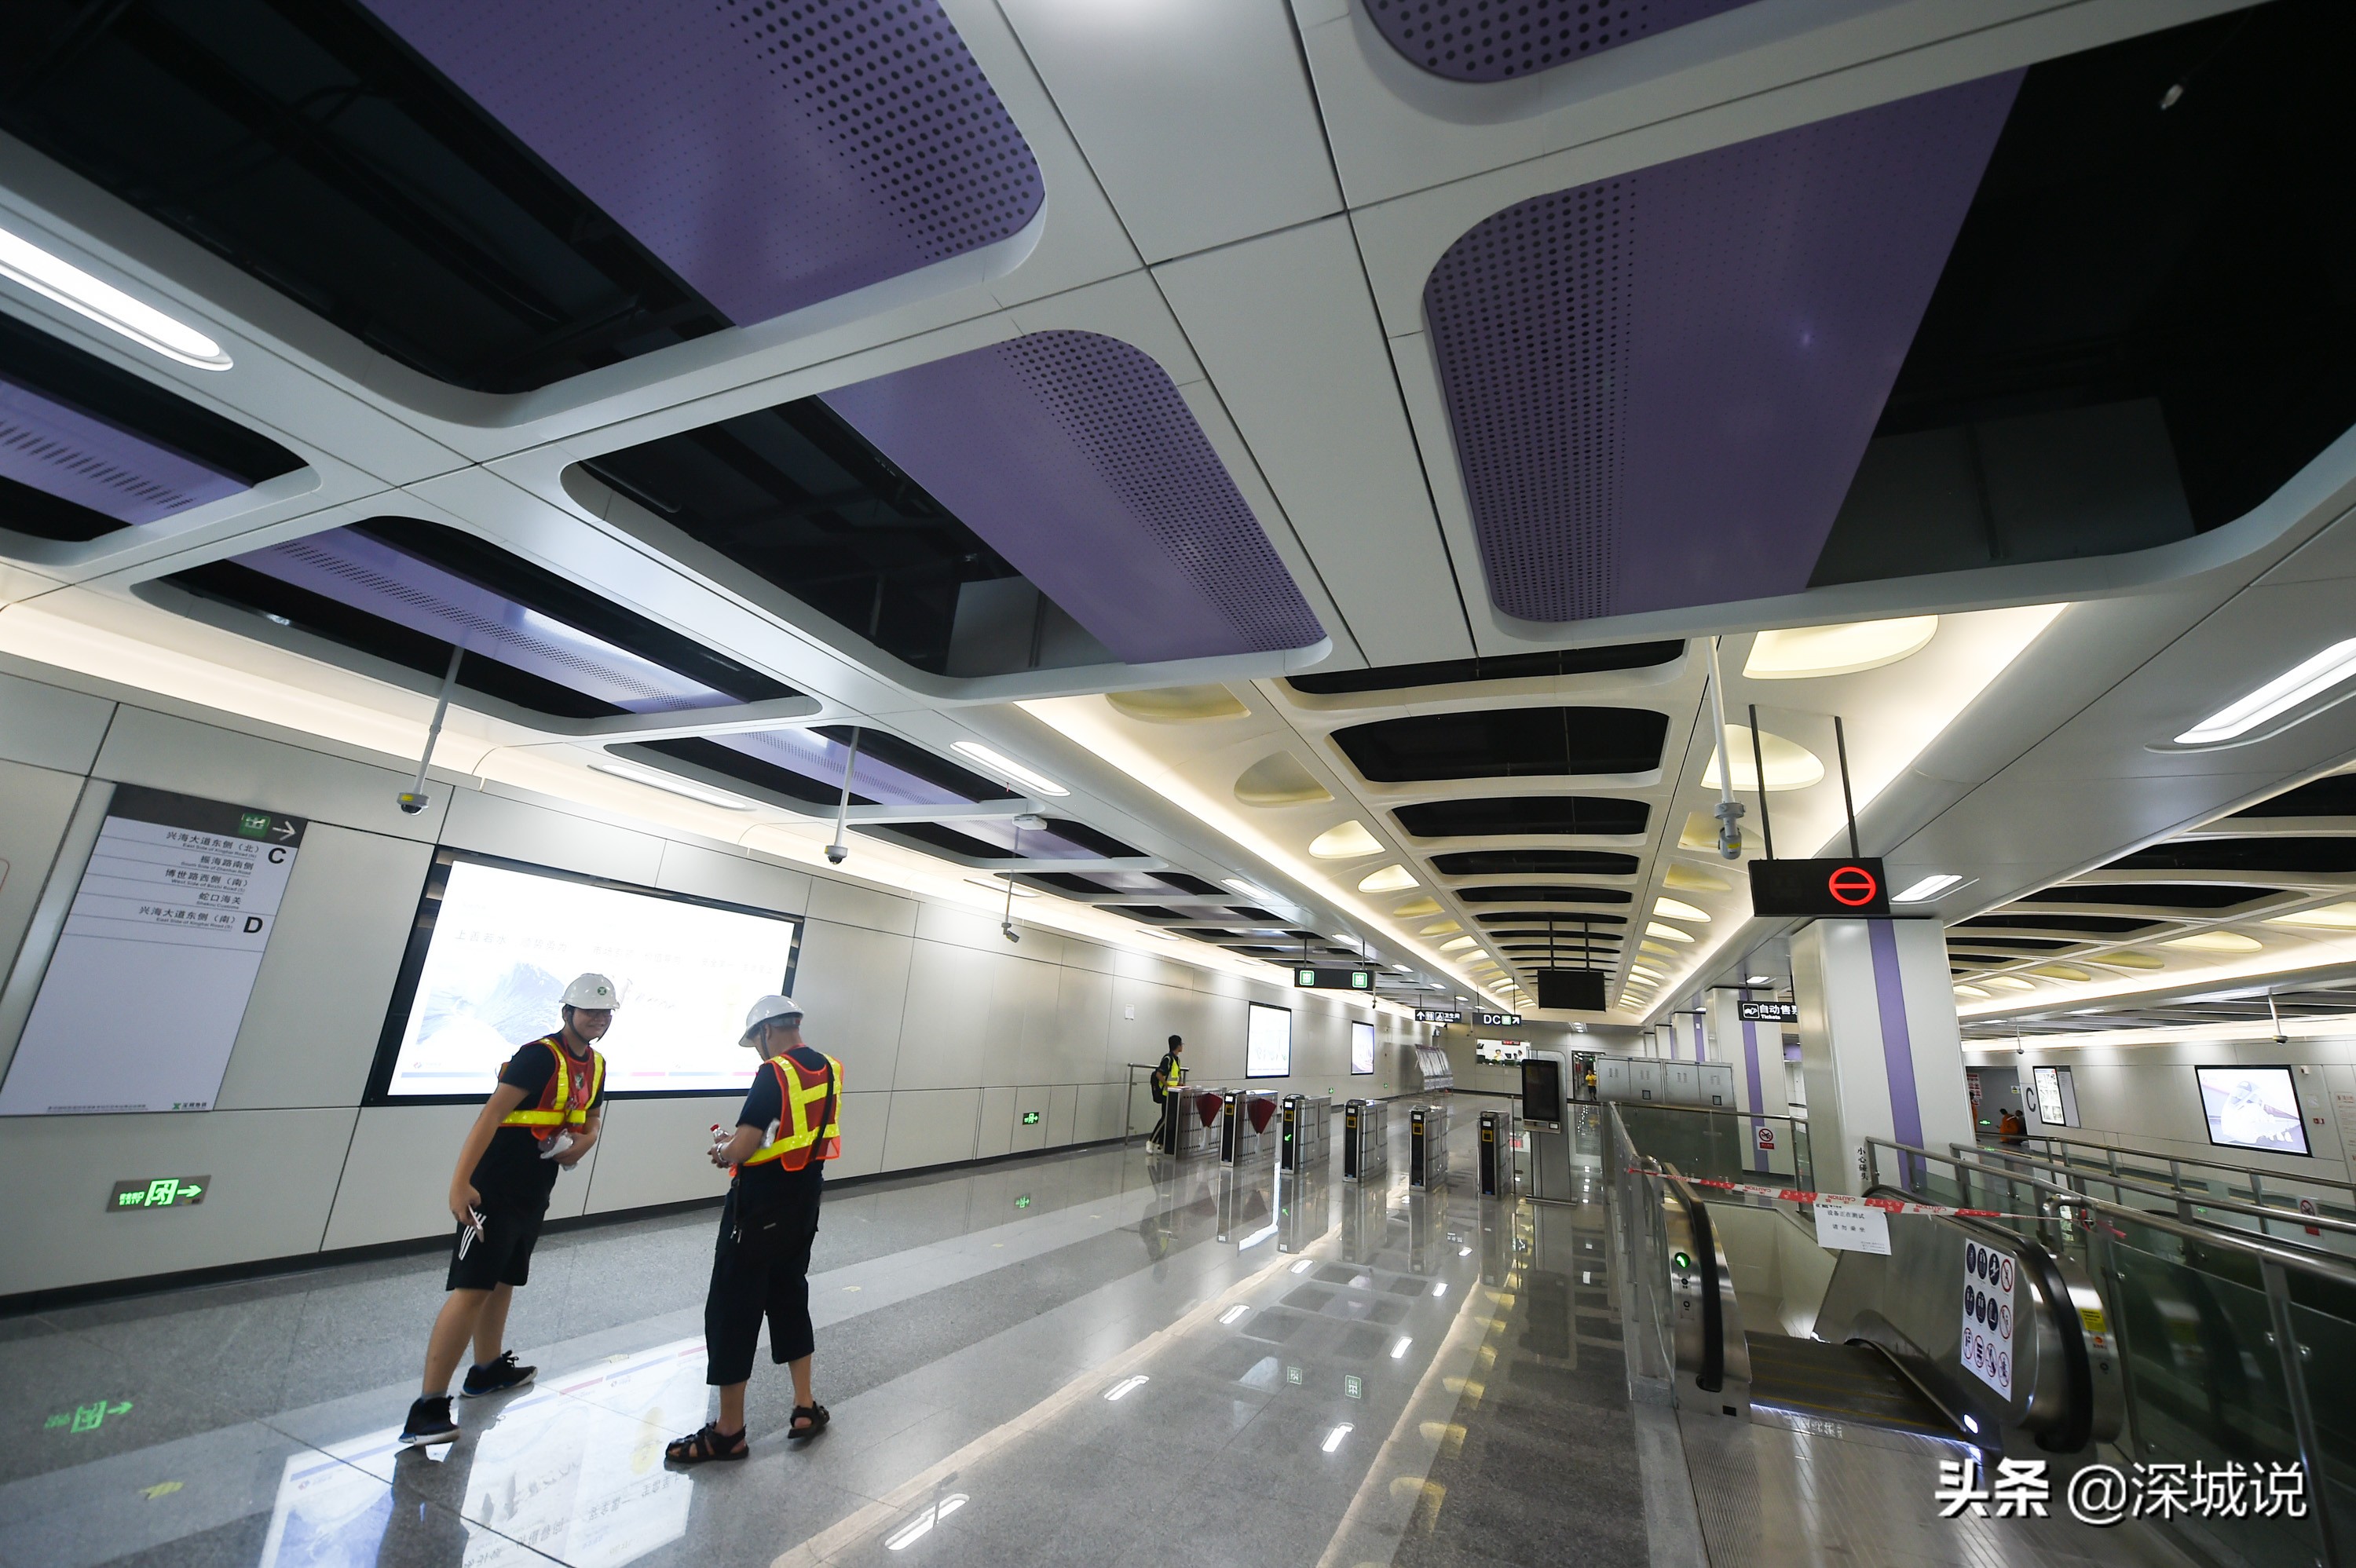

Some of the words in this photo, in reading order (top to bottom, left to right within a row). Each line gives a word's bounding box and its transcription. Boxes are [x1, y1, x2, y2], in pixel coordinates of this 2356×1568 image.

[166, 832, 259, 853] 兴海大道东侧（北）
[268, 847, 287, 864] C
[198, 892, 242, 905] 蛇口海关
[243, 916, 263, 934] D
[2026, 1087, 2036, 1112] C
[1857, 1147, 1868, 1181] 小心碰头
[1871, 1198, 1901, 1207] SAFE
[1827, 1210, 1865, 1219] 设备正在测试
